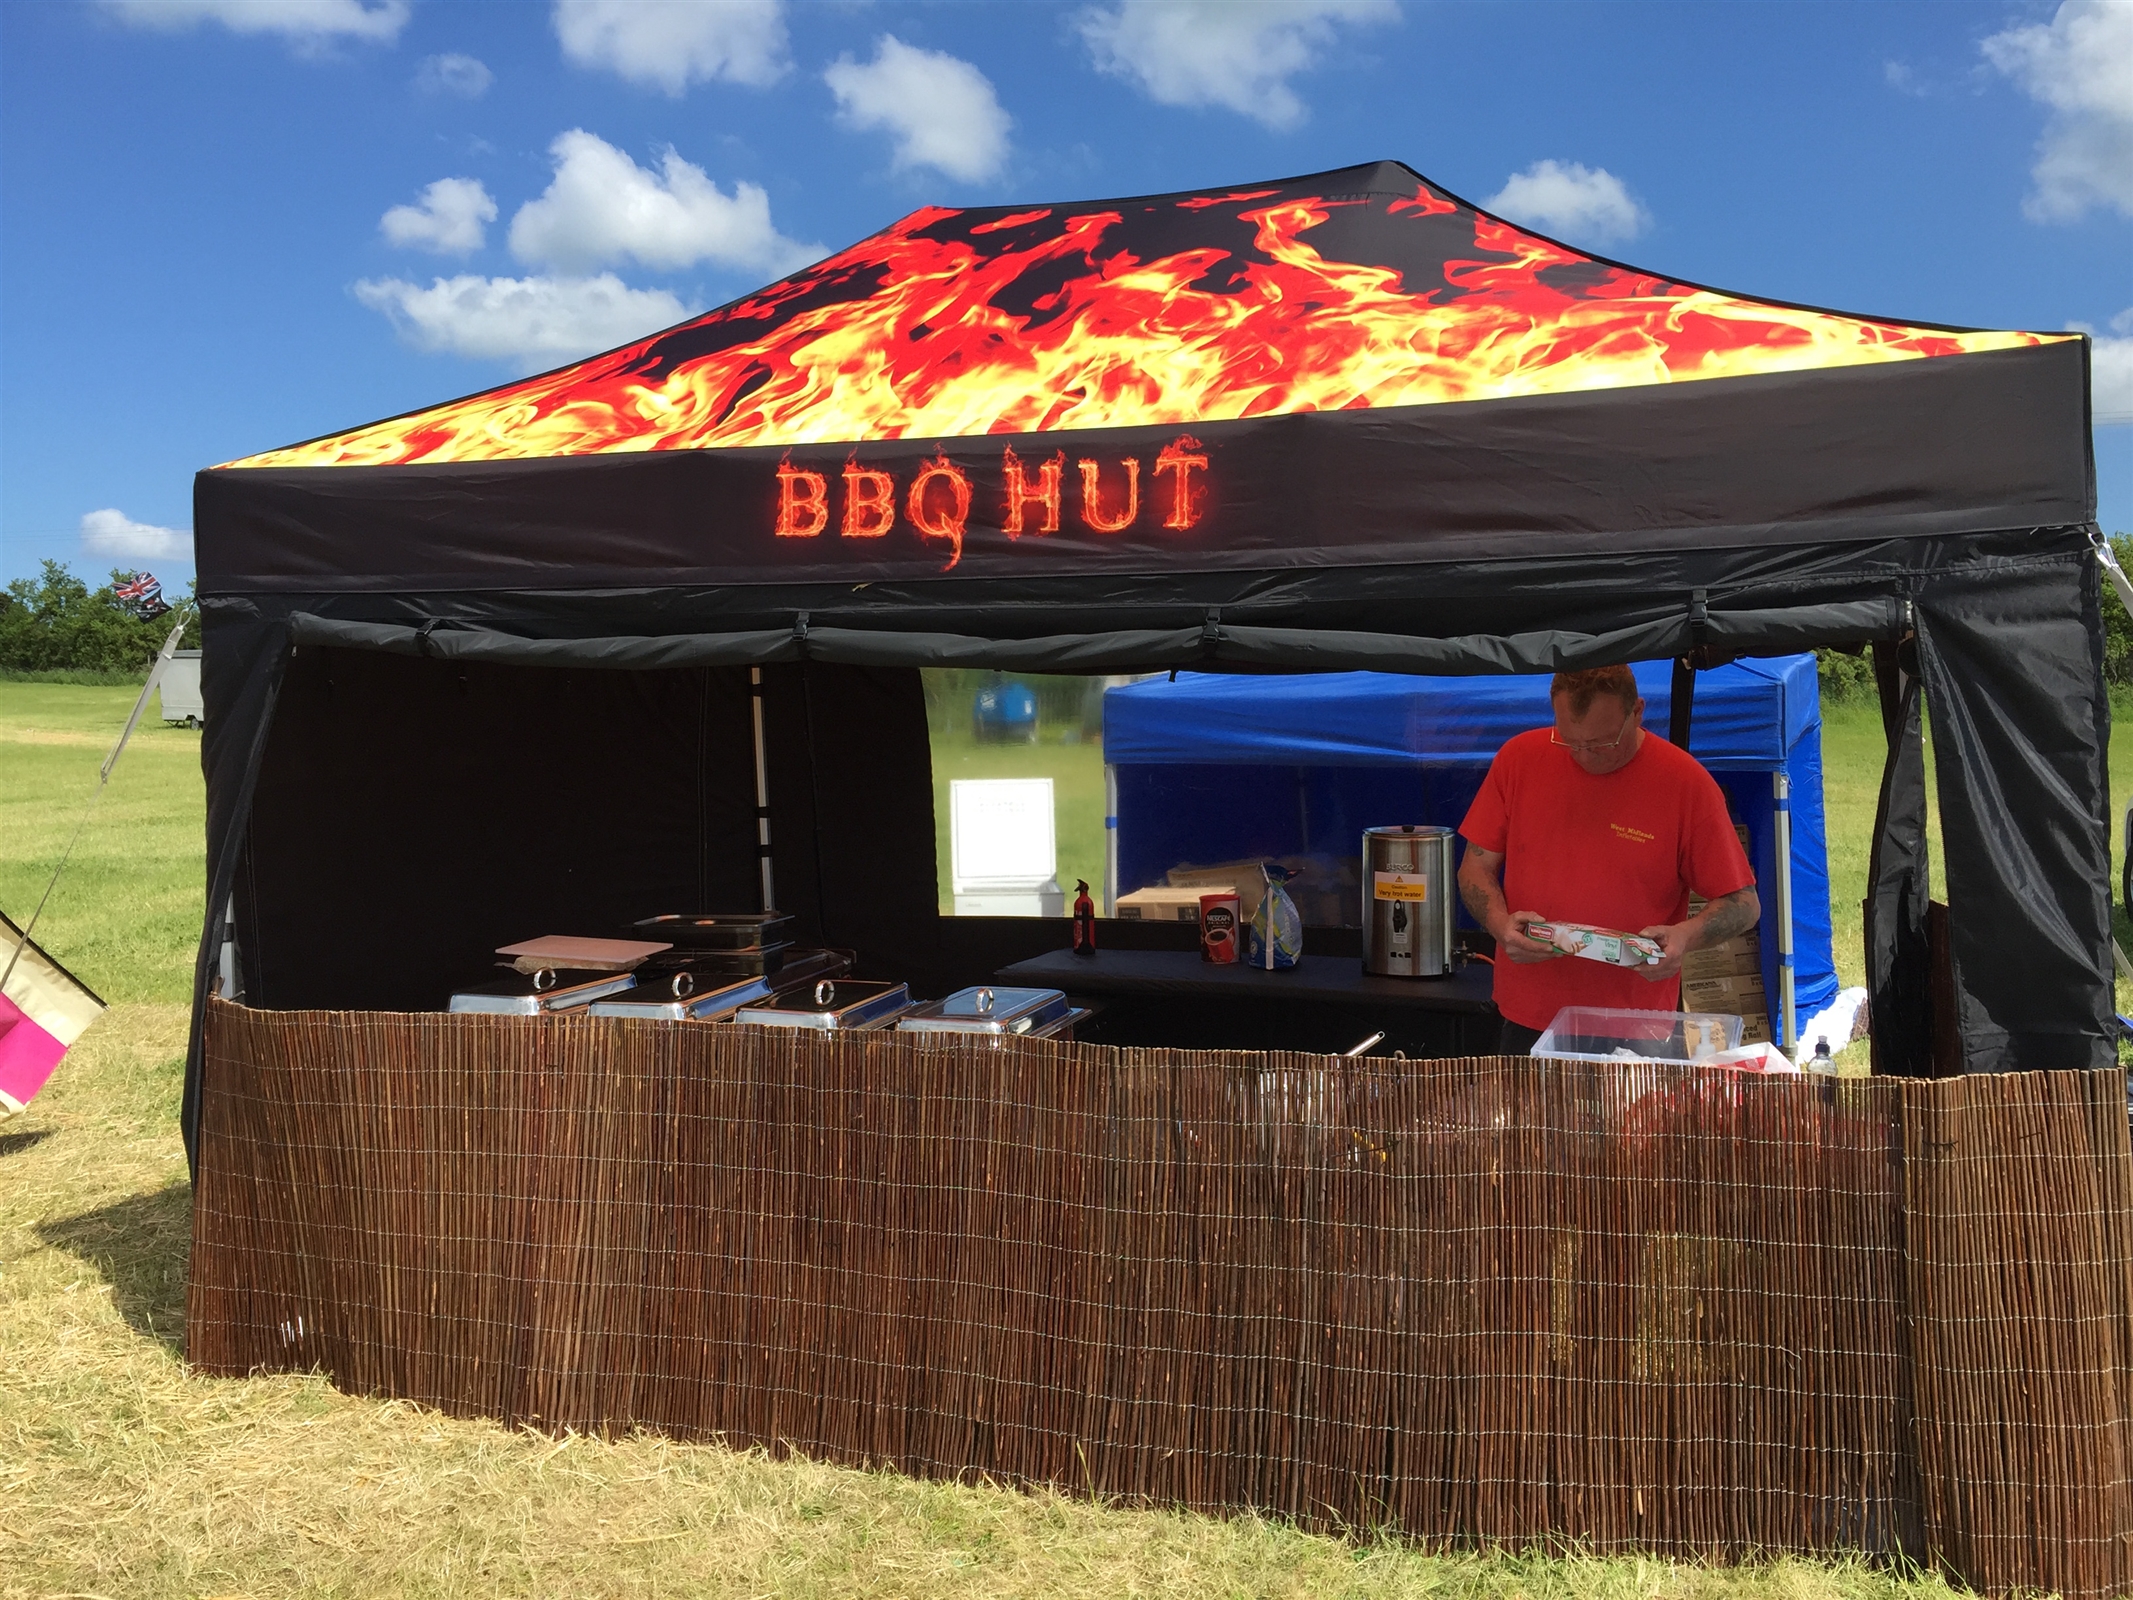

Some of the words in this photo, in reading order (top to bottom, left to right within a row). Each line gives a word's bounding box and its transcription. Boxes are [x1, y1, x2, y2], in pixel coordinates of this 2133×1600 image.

[774, 457, 974, 572] BBQ
[1001, 440, 1209, 540] HUT
[1610, 823, 1625, 832] West
[1627, 828, 1655, 840] Midlands
